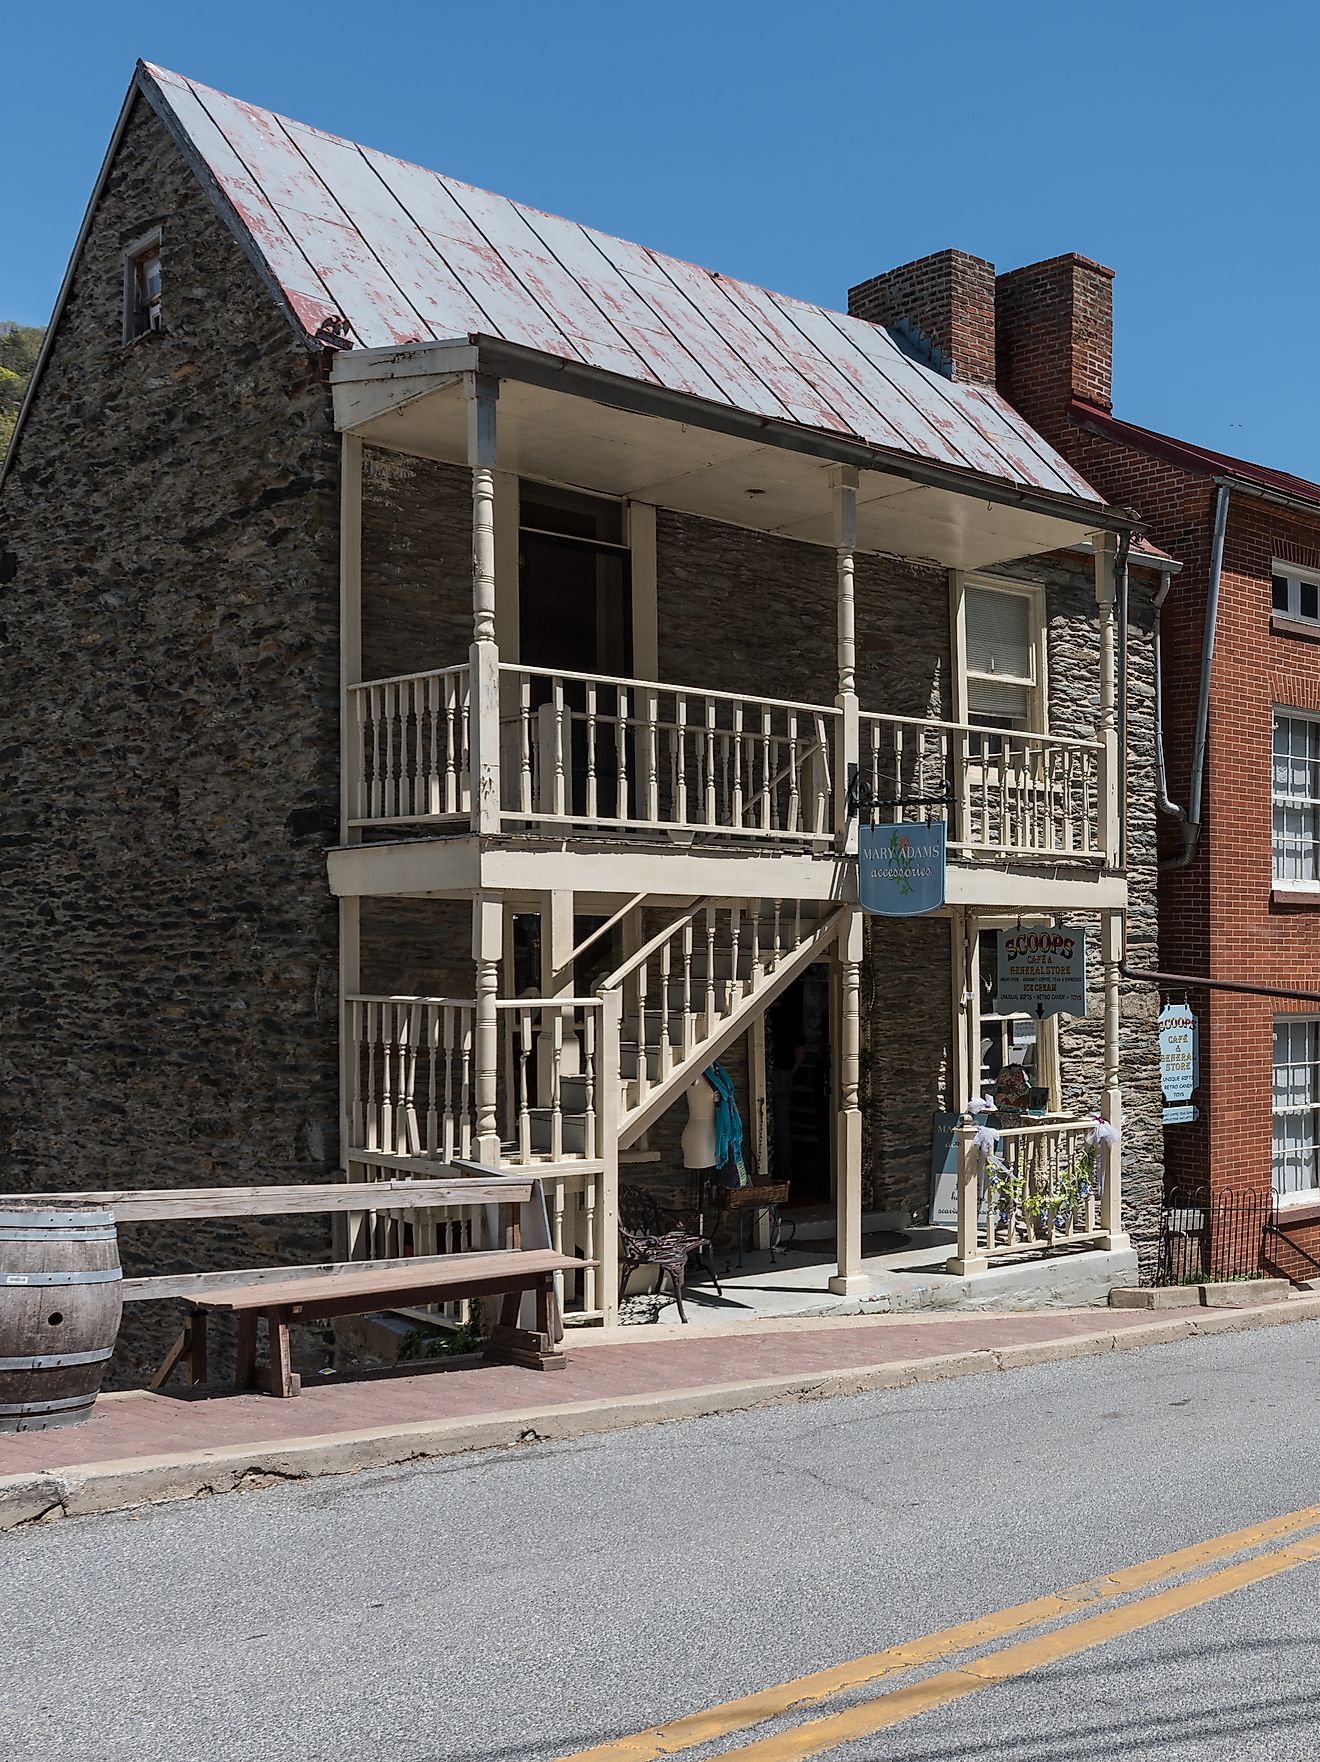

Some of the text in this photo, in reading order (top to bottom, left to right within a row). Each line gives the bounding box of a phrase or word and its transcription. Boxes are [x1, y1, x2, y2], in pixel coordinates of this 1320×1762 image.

[863, 844, 940, 860] MARY ADAMS
[870, 864, 932, 878] accessories
[1005, 931, 1076, 961] SCOOPS
[1010, 966, 1071, 975] GENERAL STORE
[1023, 983, 1057, 992] ICE CREAM
[1159, 1018, 1196, 1032] SCOOPS
[1168, 1034, 1188, 1044] CAFÉ
[1165, 1063, 1191, 1072] STORE
